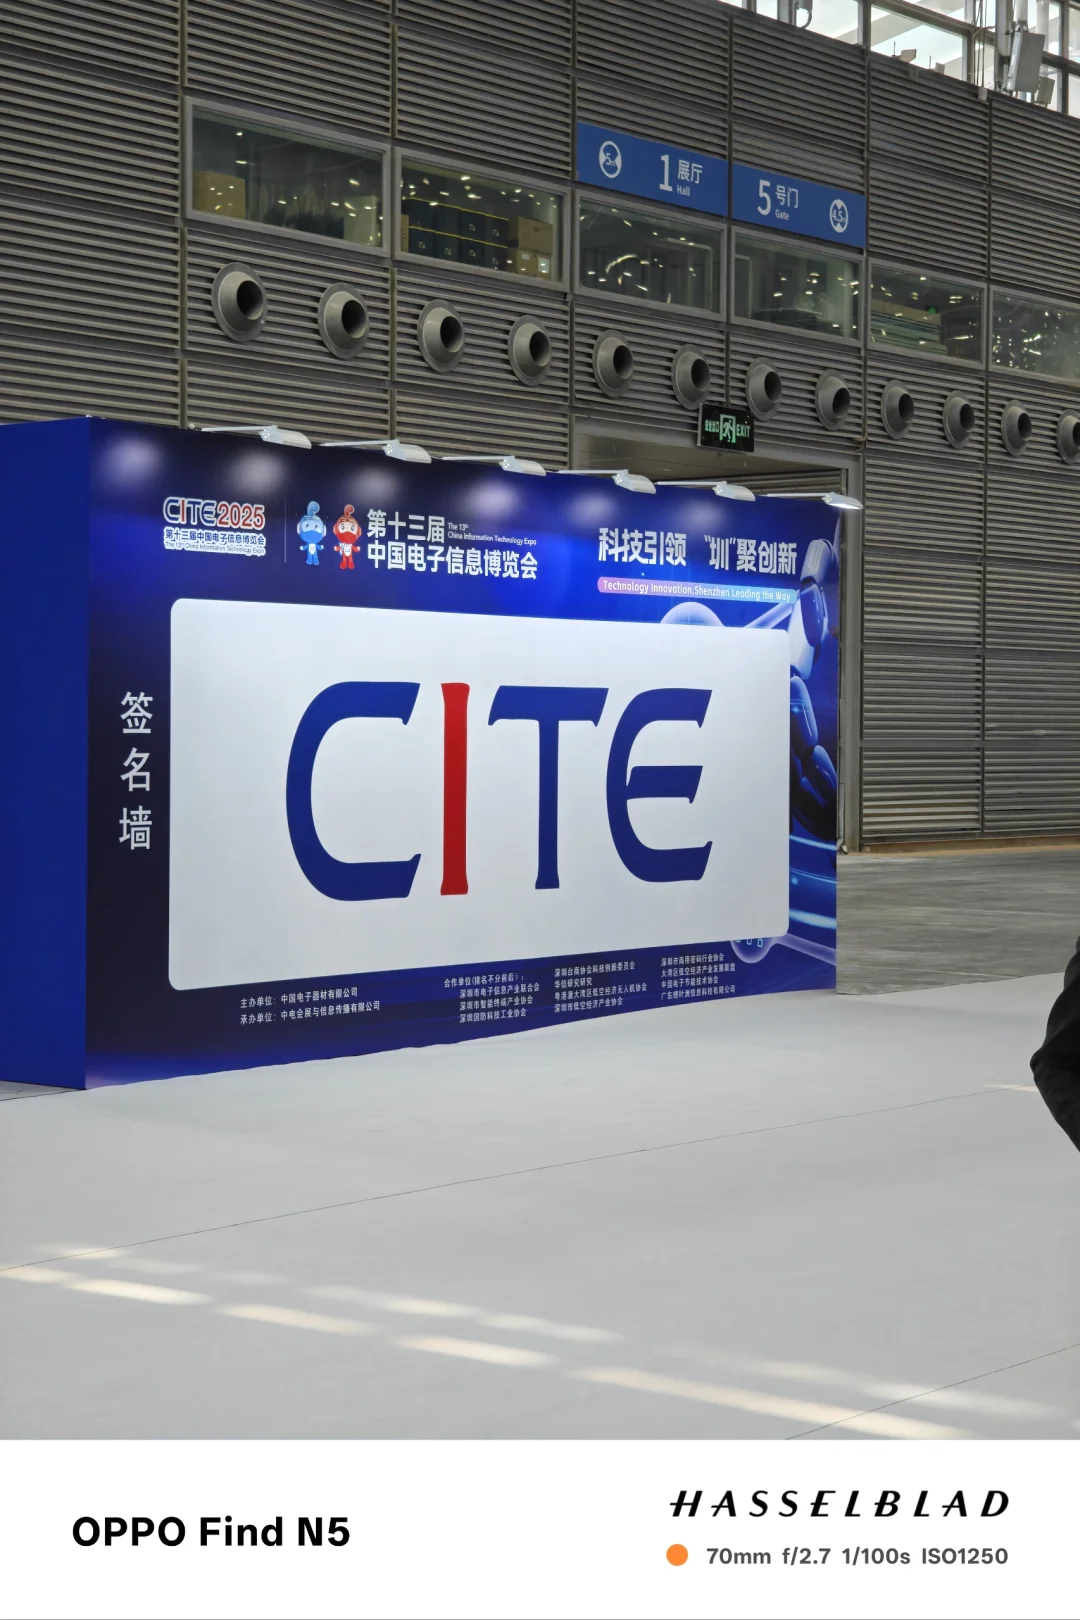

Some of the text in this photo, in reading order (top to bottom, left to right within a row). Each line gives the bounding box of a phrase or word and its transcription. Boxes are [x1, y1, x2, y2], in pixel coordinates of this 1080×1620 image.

[659, 154, 673, 192] 1
[677, 159, 703, 184] 展厅
[677, 185, 691, 197] Hall
[757, 179, 771, 215] 5
[775, 184, 799, 209] 号门
[775, 209, 789, 220] Gate
[737, 424, 751, 438] EXIT
[164, 528, 265, 545] 第十三届中国电子信息博览会
[367, 508, 445, 543] 第十三届
[448, 522, 458, 530] The
[448, 531, 537, 546] China Information Technology Expo
[598, 527, 687, 567] 科技引领
[367, 540, 538, 580] 中国电子信息博览会
[603, 580, 649, 595] Technology
[731, 588, 760, 601] Leading
[762, 590, 774, 601] the
[775, 591, 791, 603] Way
[119, 691, 153, 850] 签名墙
[286, 681, 713, 902] CITE
